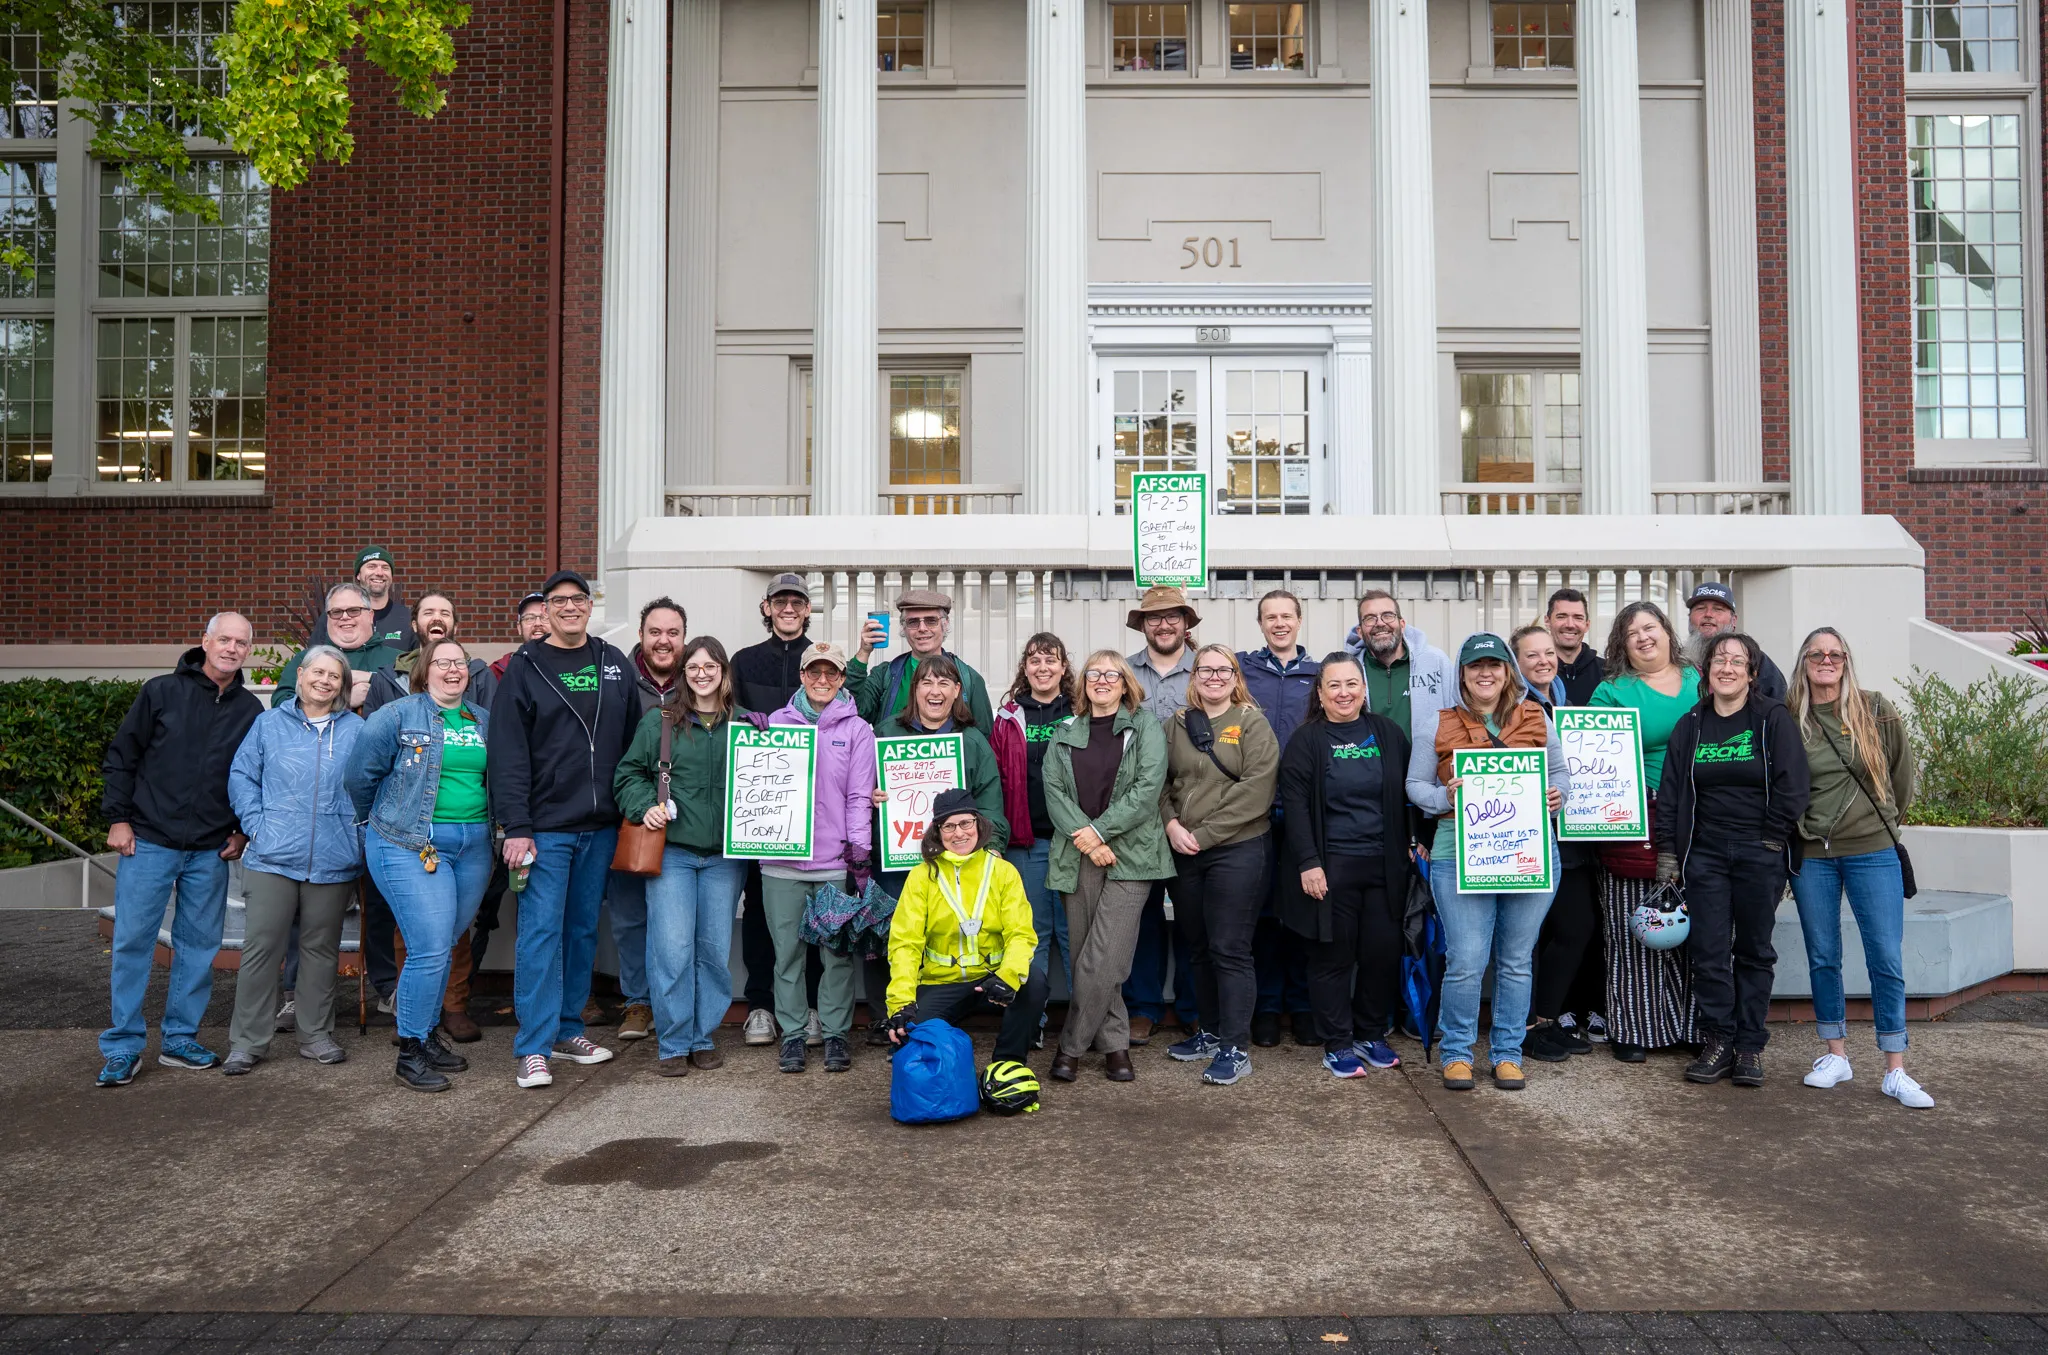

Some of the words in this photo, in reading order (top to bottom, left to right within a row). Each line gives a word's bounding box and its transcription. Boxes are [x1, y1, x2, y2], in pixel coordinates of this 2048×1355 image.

[1180, 237, 1242, 269] 501
[1200, 328, 1226, 340] 501
[1138, 477, 1201, 491] AFSCME
[1141, 493, 1188, 511] 9-2-5
[1140, 520, 1175, 534] GREAT
[1177, 521, 1196, 533] day
[1141, 543, 1178, 555] SETTLE
[1179, 541, 1198, 551] this
[1141, 555, 1198, 571] CONTRACT
[1560, 713, 1633, 729] AFSCME
[734, 729, 810, 748] AFSCME
[1025, 727, 1056, 739] AFSC
[883, 741, 956, 760] AFSCME
[1566, 731, 1626, 755] 9-25
[735, 748, 790, 772] LET'S
[1333, 746, 1381, 759] AFSCM
[884, 762, 909, 772] LOCAL
[914, 761, 936, 771] 2975
[1461, 756, 1540, 773] AFSCME
[1567, 757, 1618, 781] Dolly
[737, 773, 795, 788] SETTLE
[891, 771, 925, 781] STRIKE
[927, 770, 953, 780] VOTE
[1472, 776, 1524, 796] 9-25
[734, 789, 742, 804] A
[745, 789, 797, 804] GREAT
[733, 805, 788, 818] CONTRACT
[1464, 798, 1517, 828] Dolly
[893, 819, 929, 848] YE
[1467, 832, 1491, 840] WOULD
[1492, 830, 1514, 839] WANT
[1517, 830, 1527, 838] US
[1528, 828, 1539, 837] TO
[1631, 823, 1641, 831] 75
[1493, 838, 1529, 851] GREAT
[1468, 854, 1515, 867] CONTRACT
[1499, 875, 1534, 883] COUNCIL
